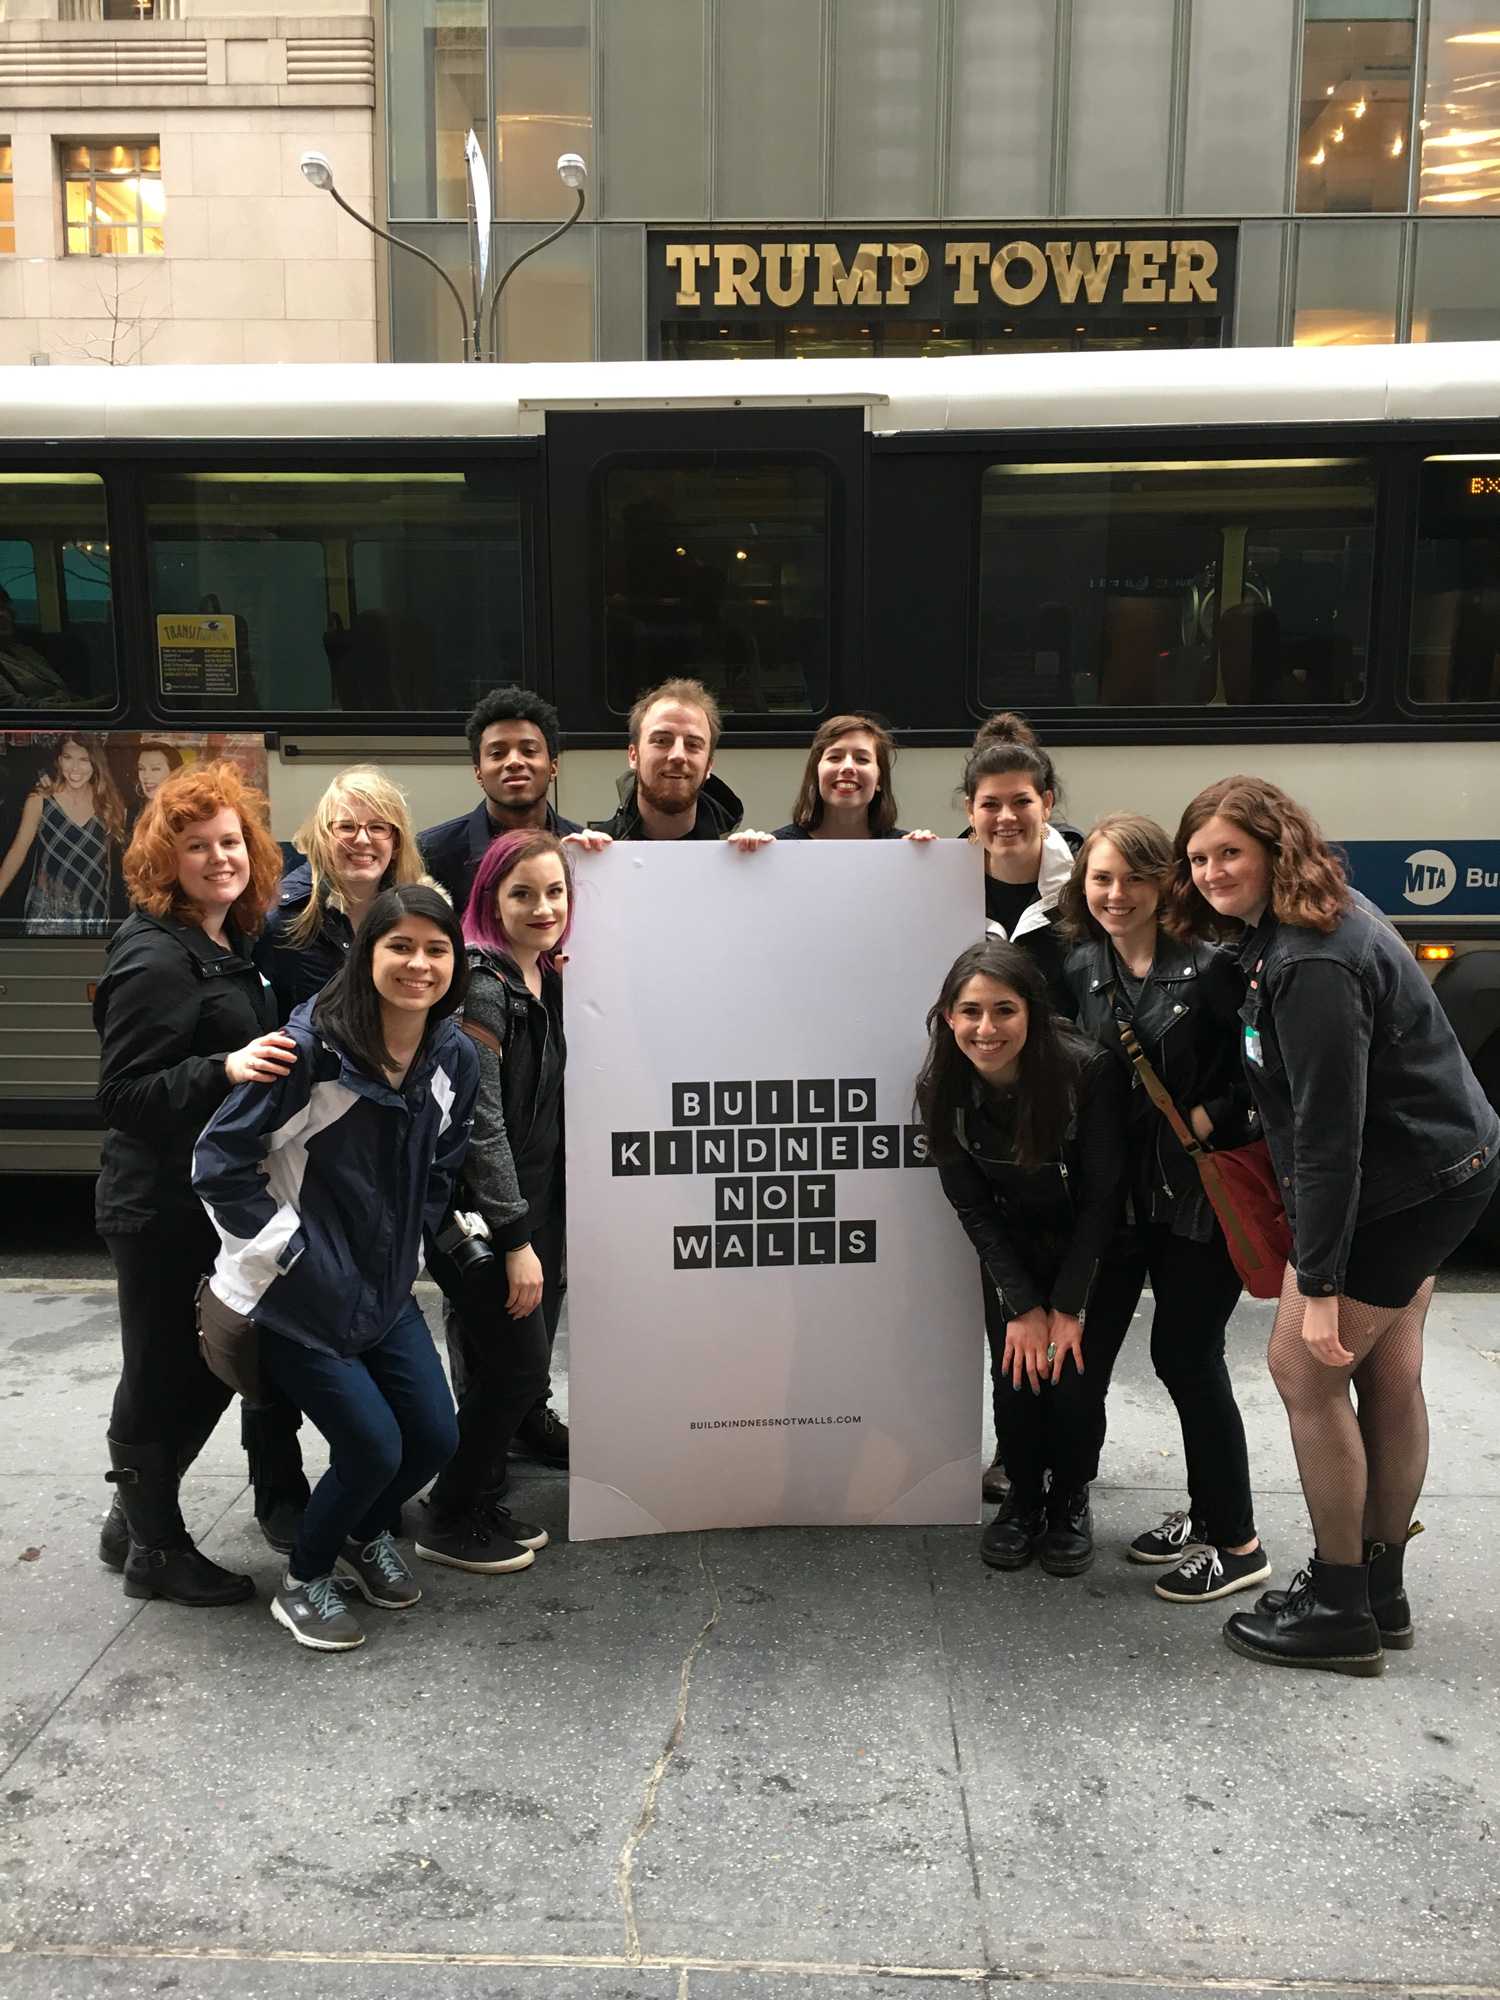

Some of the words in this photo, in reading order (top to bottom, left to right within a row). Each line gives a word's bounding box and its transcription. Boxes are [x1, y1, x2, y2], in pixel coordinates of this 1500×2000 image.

[665, 242, 930, 308] TRUMP
[945, 238, 1219, 307] TOWER
[1403, 863, 1446, 893] MTA
[1465, 867, 1500, 888] Bu
[683, 1087, 869, 1117] BUILD
[620, 1133, 930, 1167] KINDNESS
[723, 1183, 827, 1212] NOT
[676, 1229, 867, 1261] WALLS
[689, 1414, 863, 1431] BUILDKINDNESSNOTWALLS.COM
